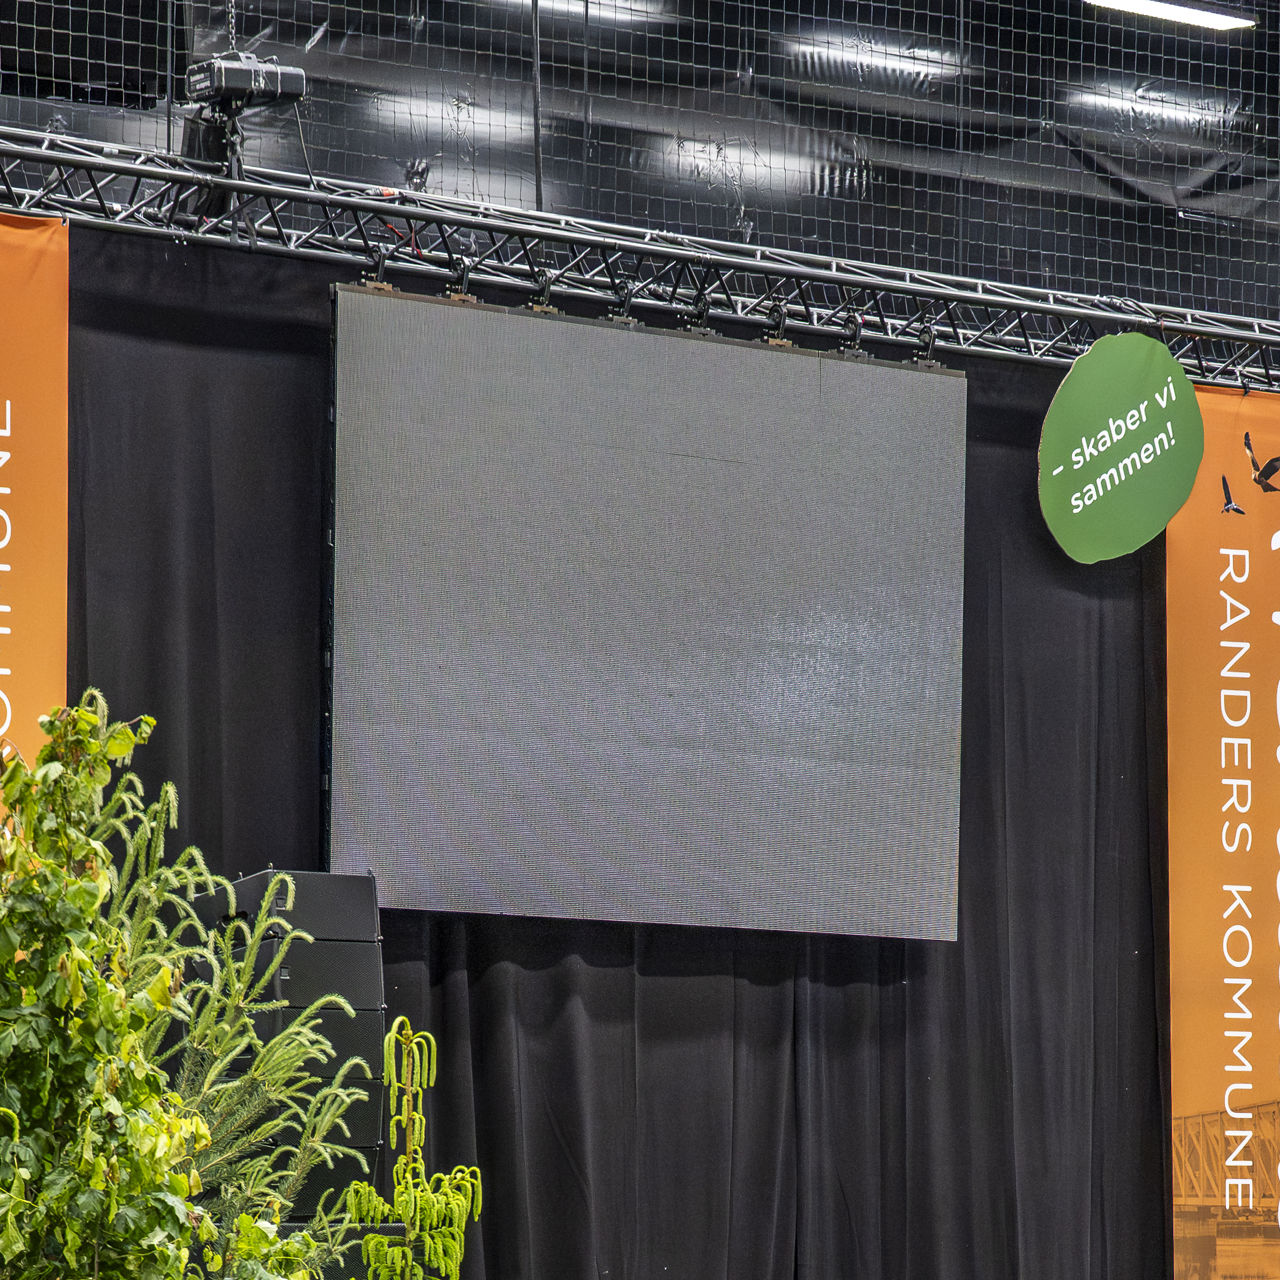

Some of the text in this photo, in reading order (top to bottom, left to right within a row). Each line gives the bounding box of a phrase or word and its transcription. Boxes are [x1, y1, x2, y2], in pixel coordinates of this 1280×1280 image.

[1071, 400, 1148, 470] skaber
[1154, 376, 1176, 408] vi
[1071, 421, 1176, 514] sammen!
[1219, 548, 1253, 1210] RANDERS KOMMUNE
